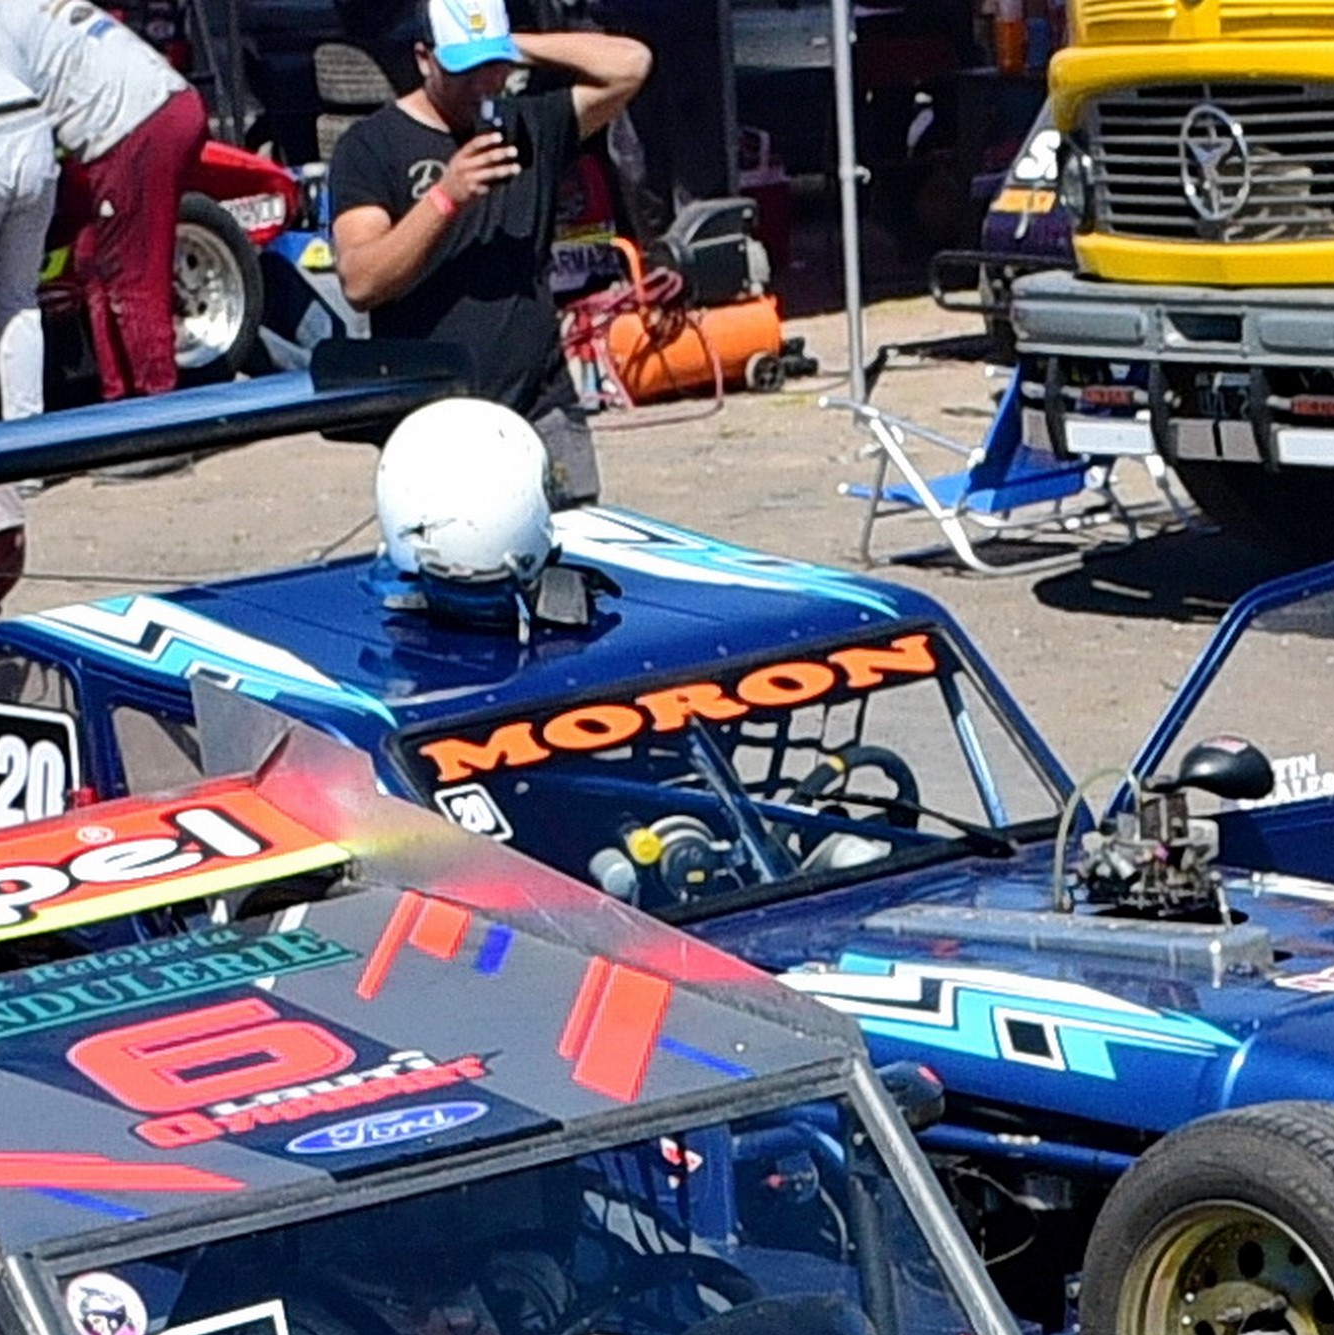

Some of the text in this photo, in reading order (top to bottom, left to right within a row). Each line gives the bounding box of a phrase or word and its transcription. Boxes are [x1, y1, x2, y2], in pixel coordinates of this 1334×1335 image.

[420, 634, 936, 782] MORON
[451, 794, 496, 833] 20
[66, 997, 357, 1113] 6
